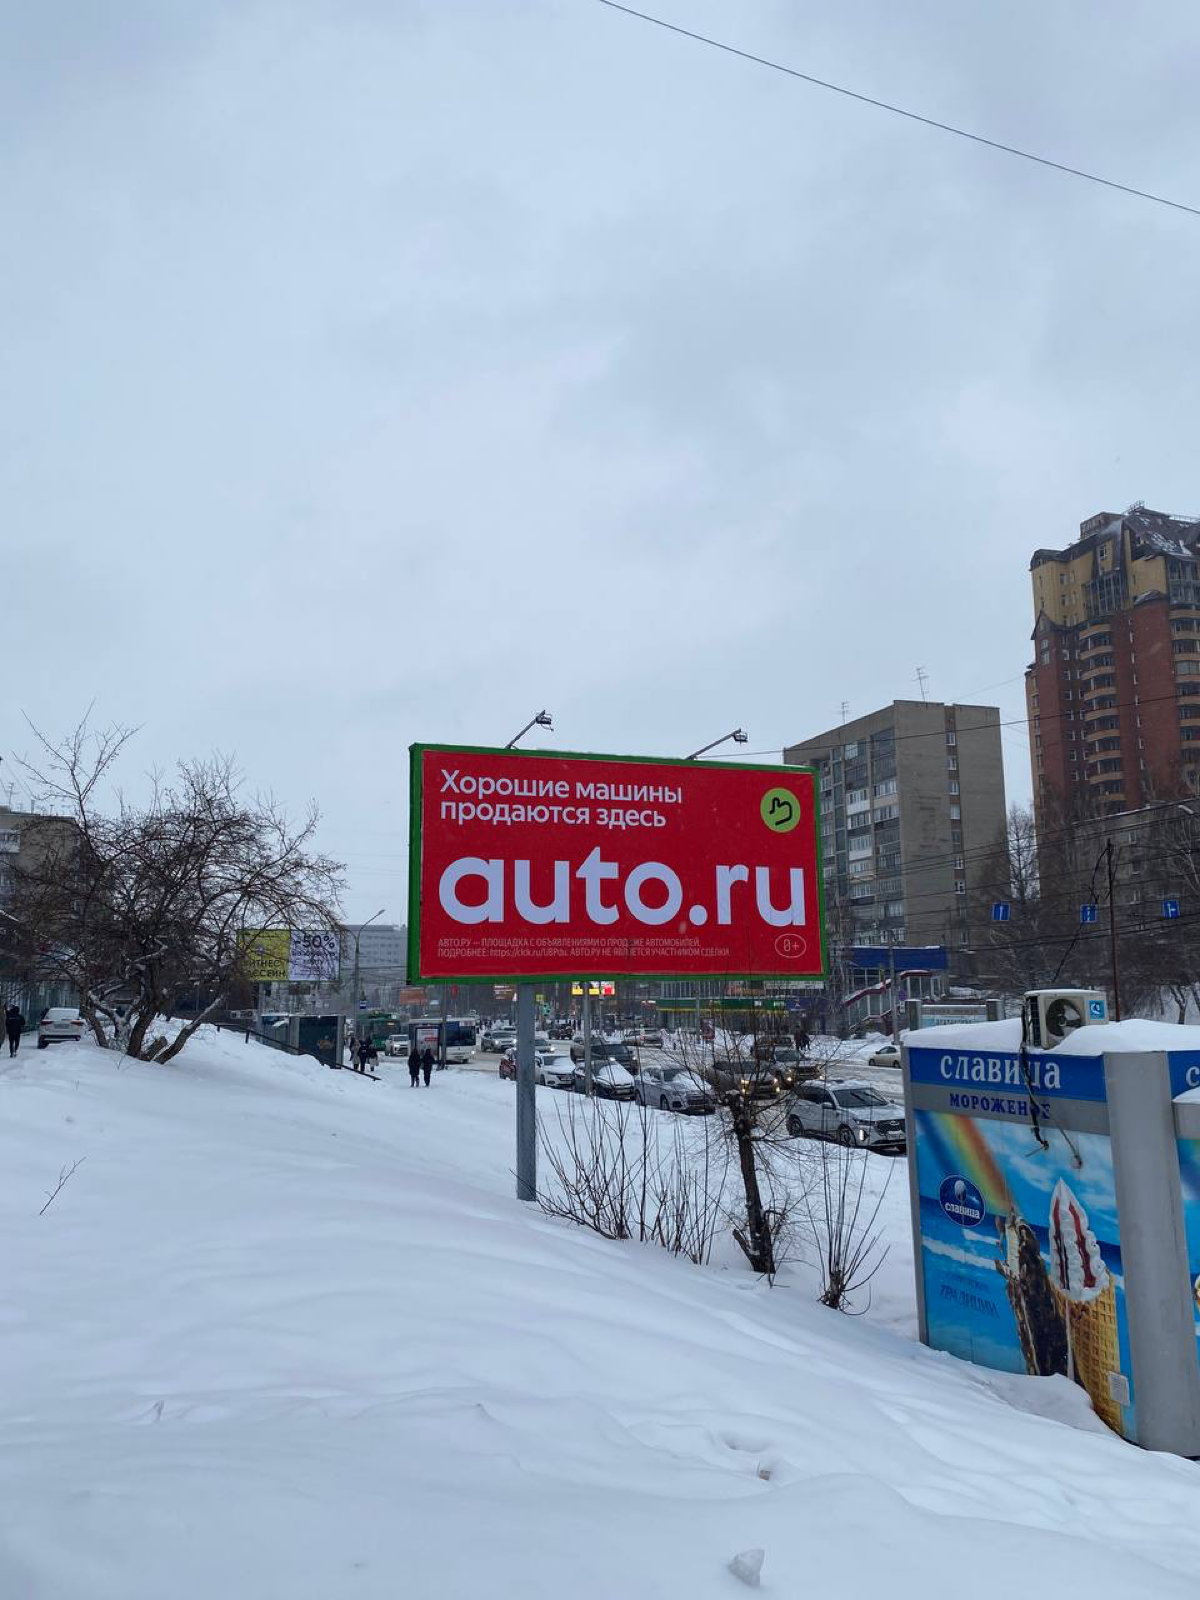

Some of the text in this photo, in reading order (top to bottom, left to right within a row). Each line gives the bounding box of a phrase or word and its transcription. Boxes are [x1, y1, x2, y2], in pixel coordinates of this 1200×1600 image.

[441, 769, 682, 804] Хорошие машины
[441, 800, 667, 830] продаются здесь
[438, 846, 806, 926] auto.ru
[437, 948, 489, 959] ПОДРОБНЕЕ:
[570, 948, 602, 957] АВТО.РУ
[602, 948, 612, 957] НЕ
[651, 948, 700, 957] УЧАСТНИКОМ
[438, 938, 472, 947] АВТО.РУ
[481, 938, 530, 948] ПЛОЩАДКА
[536, 938, 600, 947] ОБЪЯВЛЕНИЯМИ
[940, 1055, 1061, 1089] славица
[944, 1202, 981, 1219] славица
